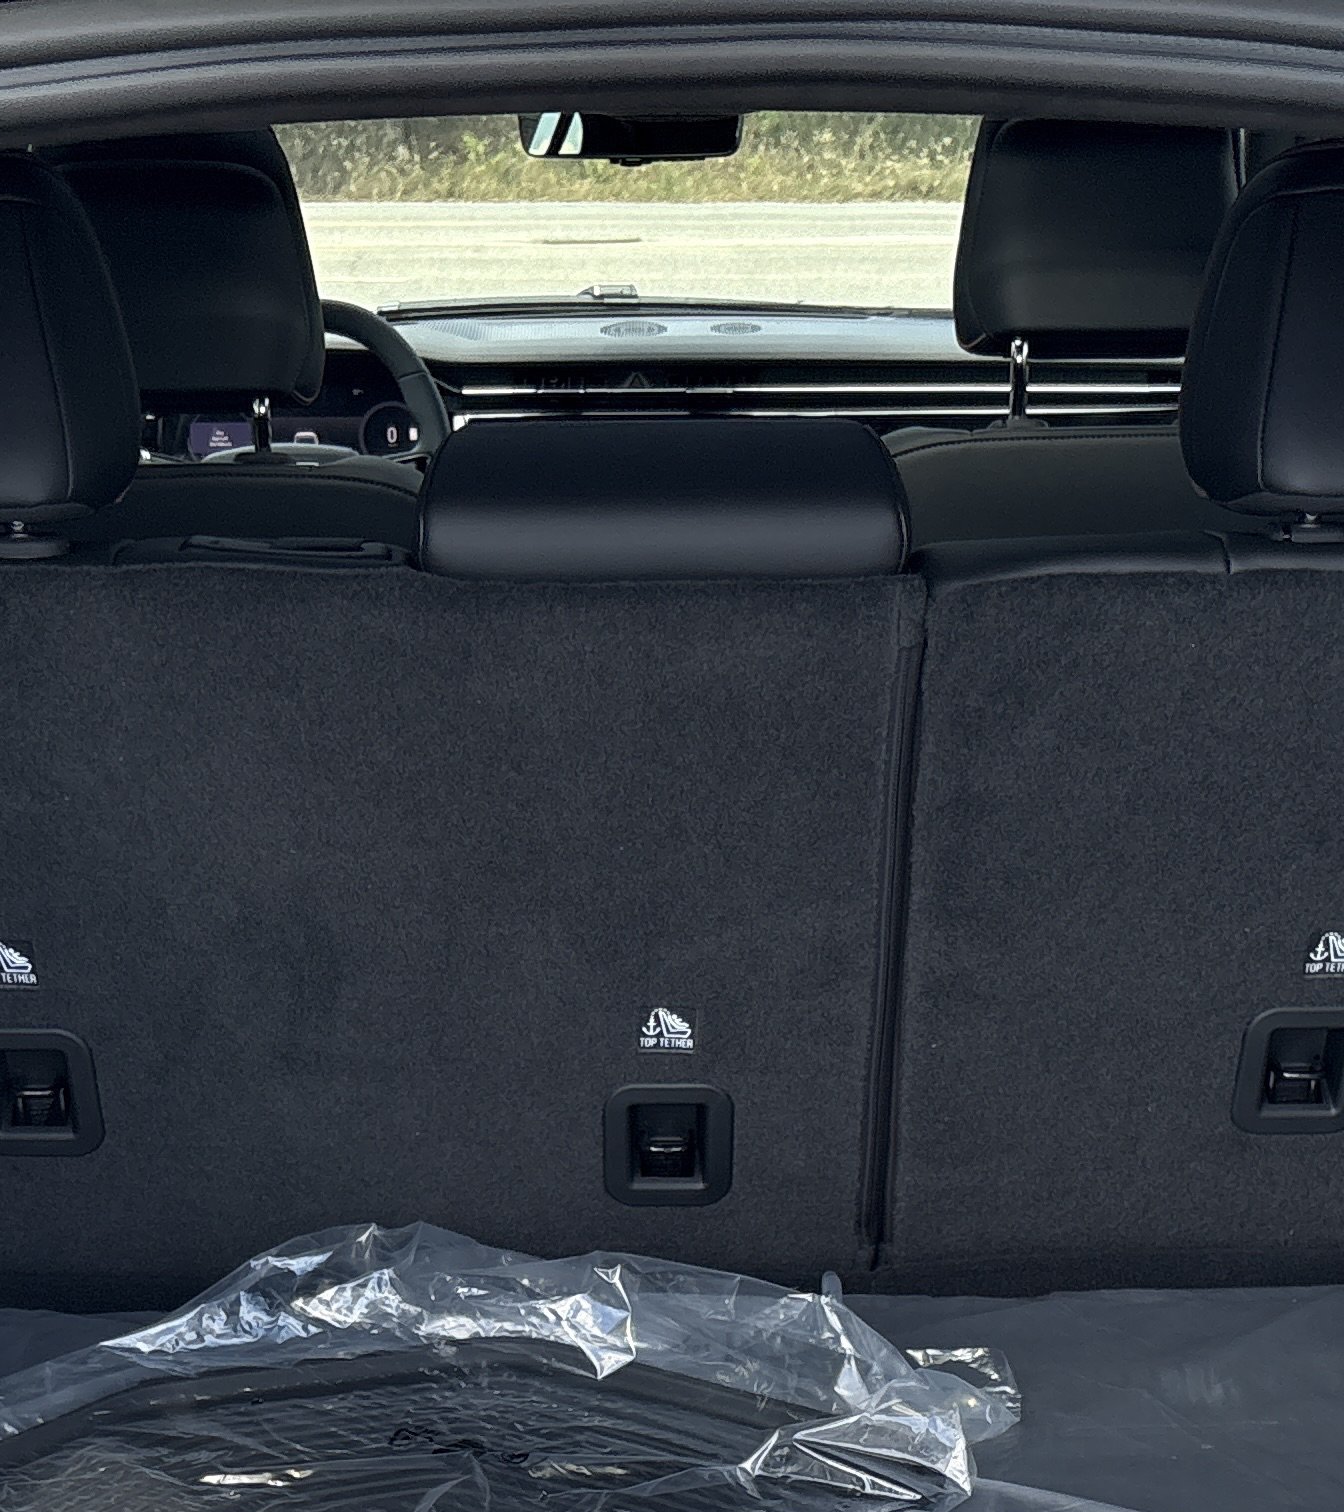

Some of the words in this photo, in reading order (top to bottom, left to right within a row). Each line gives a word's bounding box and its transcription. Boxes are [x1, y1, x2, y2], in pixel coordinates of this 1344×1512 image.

[1305, 962, 1323, 973] TOP
[0, 972, 37, 984] TETHER
[639, 1037, 657, 1047] TOP
[659, 1037, 694, 1049] TETHER
